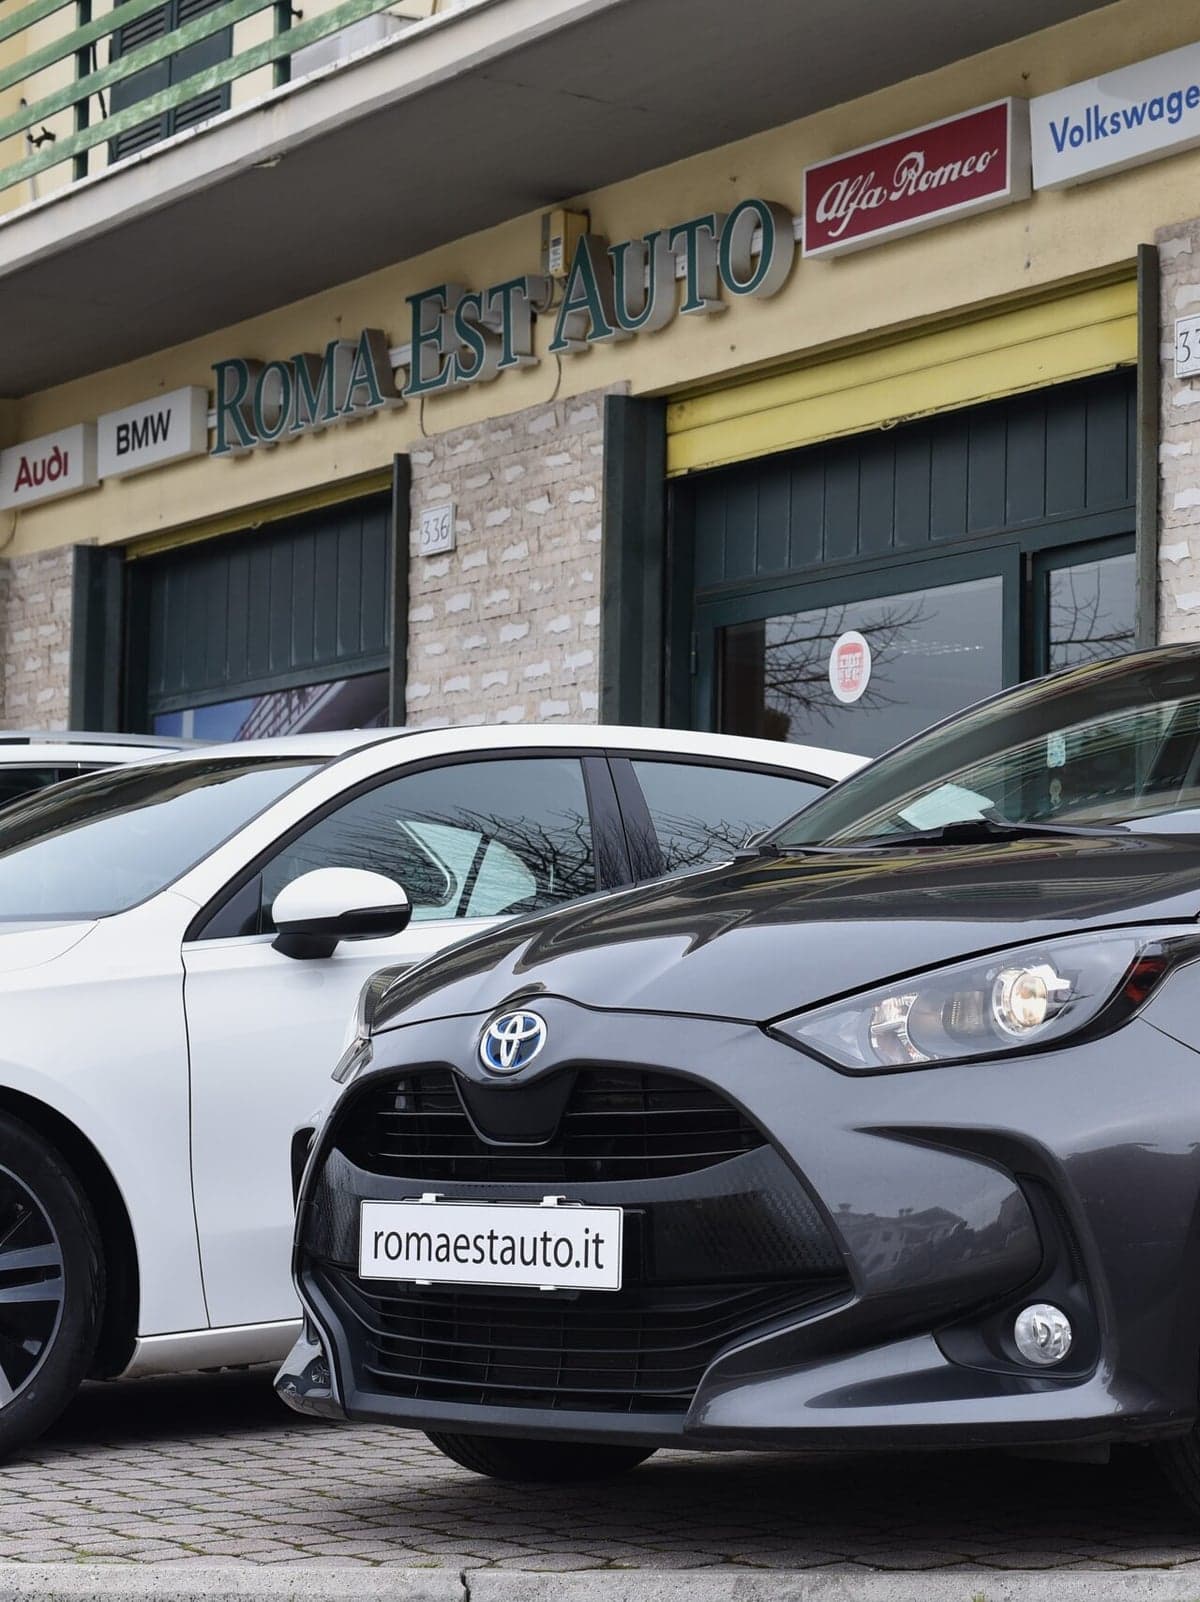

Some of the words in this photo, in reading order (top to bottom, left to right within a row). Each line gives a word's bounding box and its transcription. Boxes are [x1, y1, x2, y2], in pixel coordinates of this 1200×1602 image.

[816, 171, 887, 237] Alfa
[890, 150, 998, 201] Romeo
[210, 328, 385, 458] ROMA
[402, 275, 528, 397] EST
[548, 198, 775, 352] AUTO
[116, 409, 172, 456] BMW
[14, 446, 69, 493] Audi
[423, 513, 450, 545] 336
[373, 1227, 605, 1270] romaestauto.it
